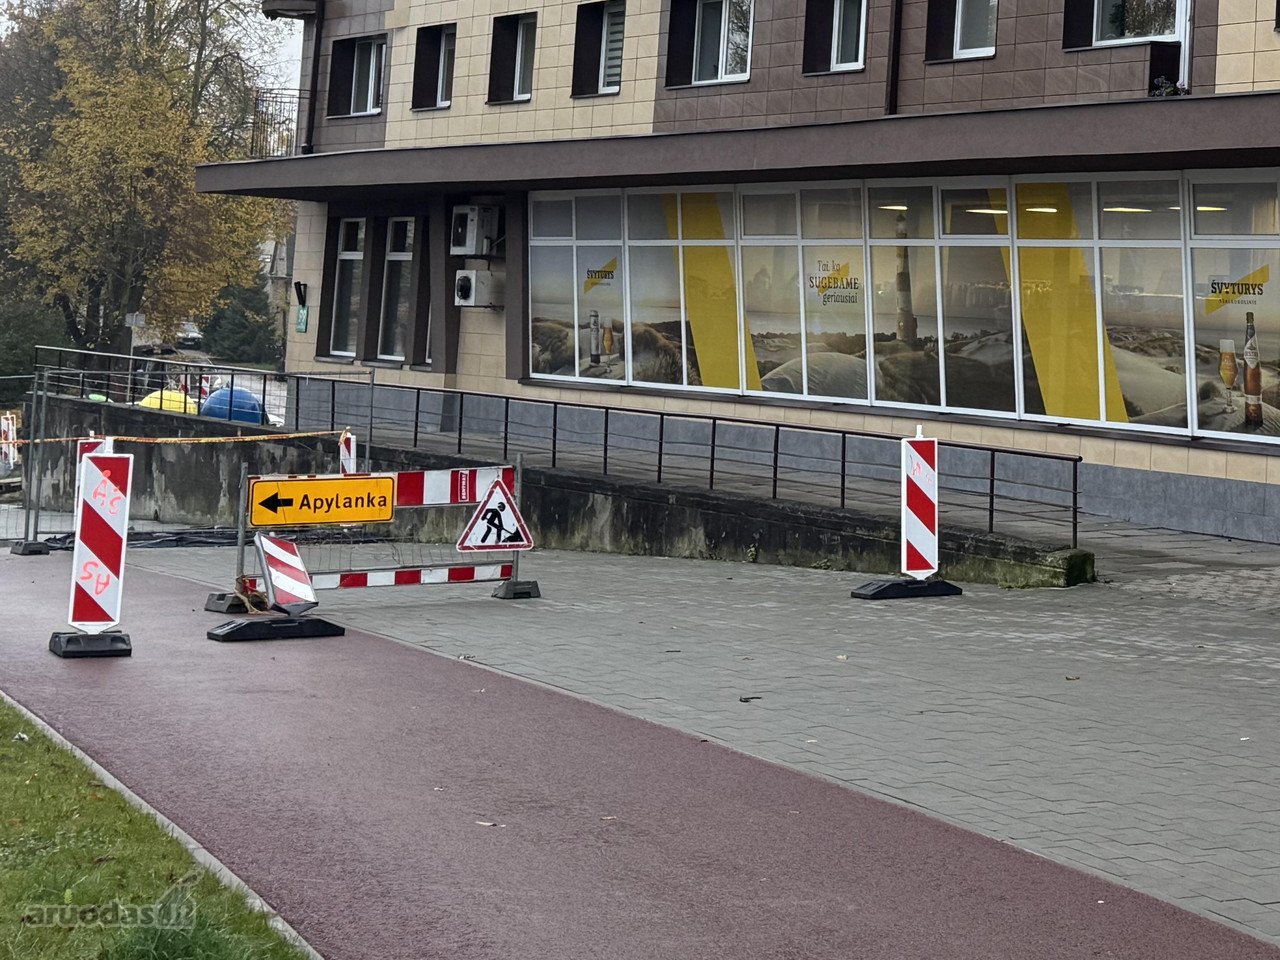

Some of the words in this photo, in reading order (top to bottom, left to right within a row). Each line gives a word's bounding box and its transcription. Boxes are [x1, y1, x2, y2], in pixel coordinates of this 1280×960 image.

[809, 276, 859, 290] SUGEBAME
[1211, 280, 1264, 295] ŠVYTURYS
[823, 292, 858, 306] geriausiai
[299, 492, 387, 514] Apylanka
